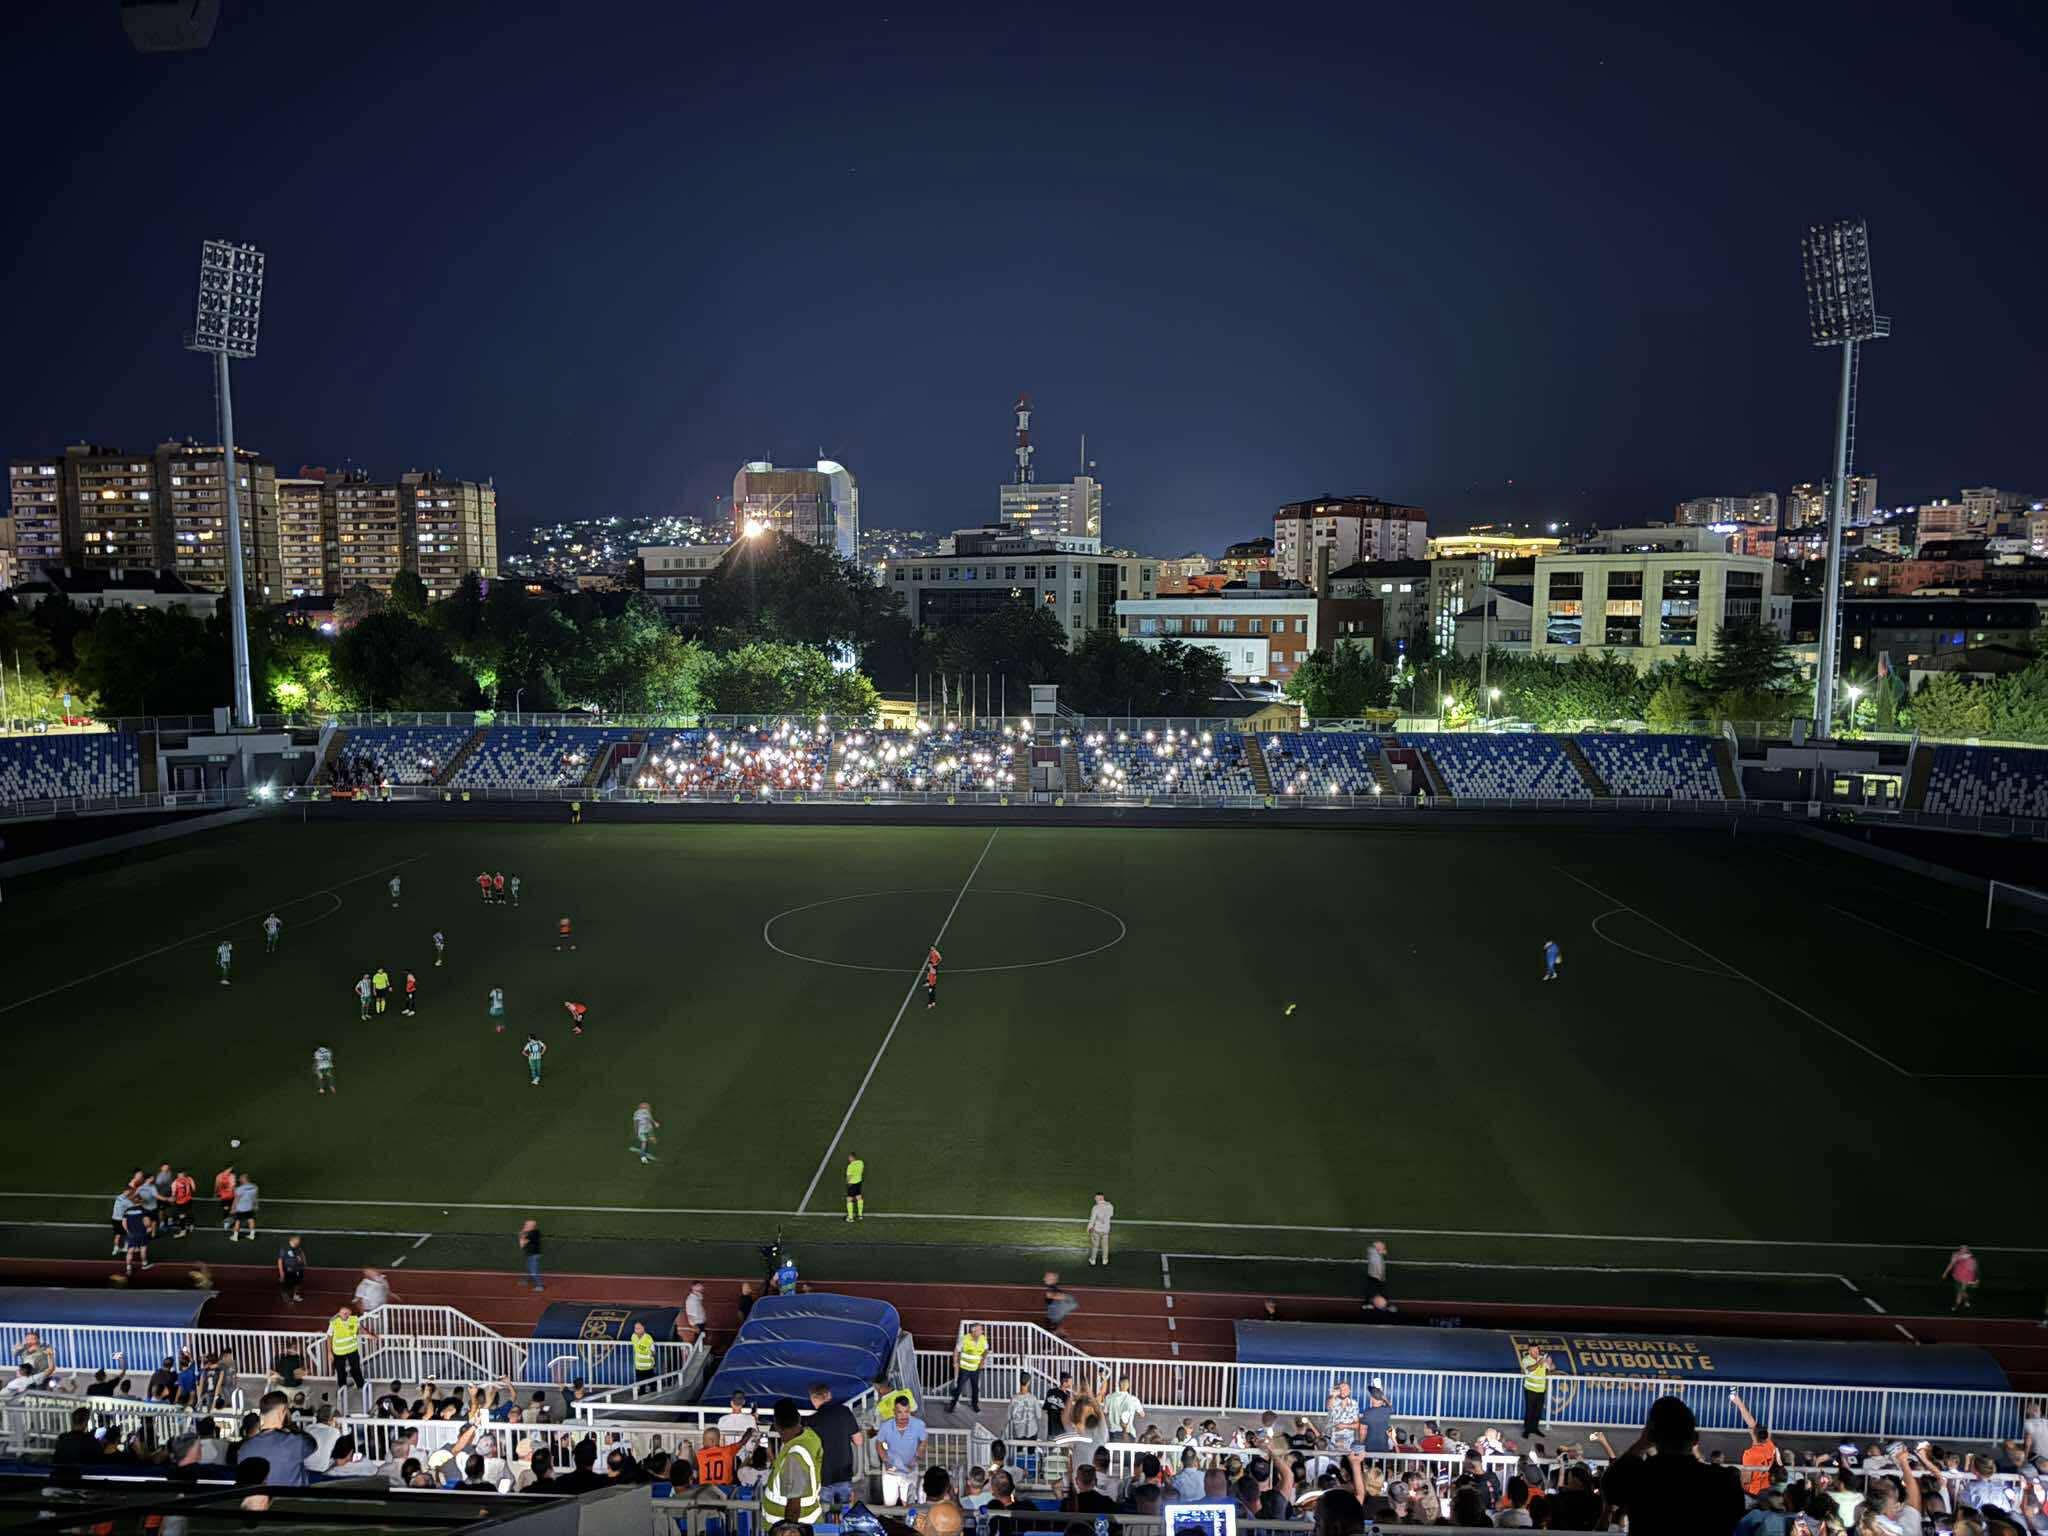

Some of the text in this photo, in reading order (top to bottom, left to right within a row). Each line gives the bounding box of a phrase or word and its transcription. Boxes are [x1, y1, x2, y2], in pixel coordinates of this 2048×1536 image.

[1574, 1339, 1700, 1353] FEDERATA E
[1580, 1352, 1715, 1371] FUTBOLLIT E
[704, 1460, 723, 1481] 10
